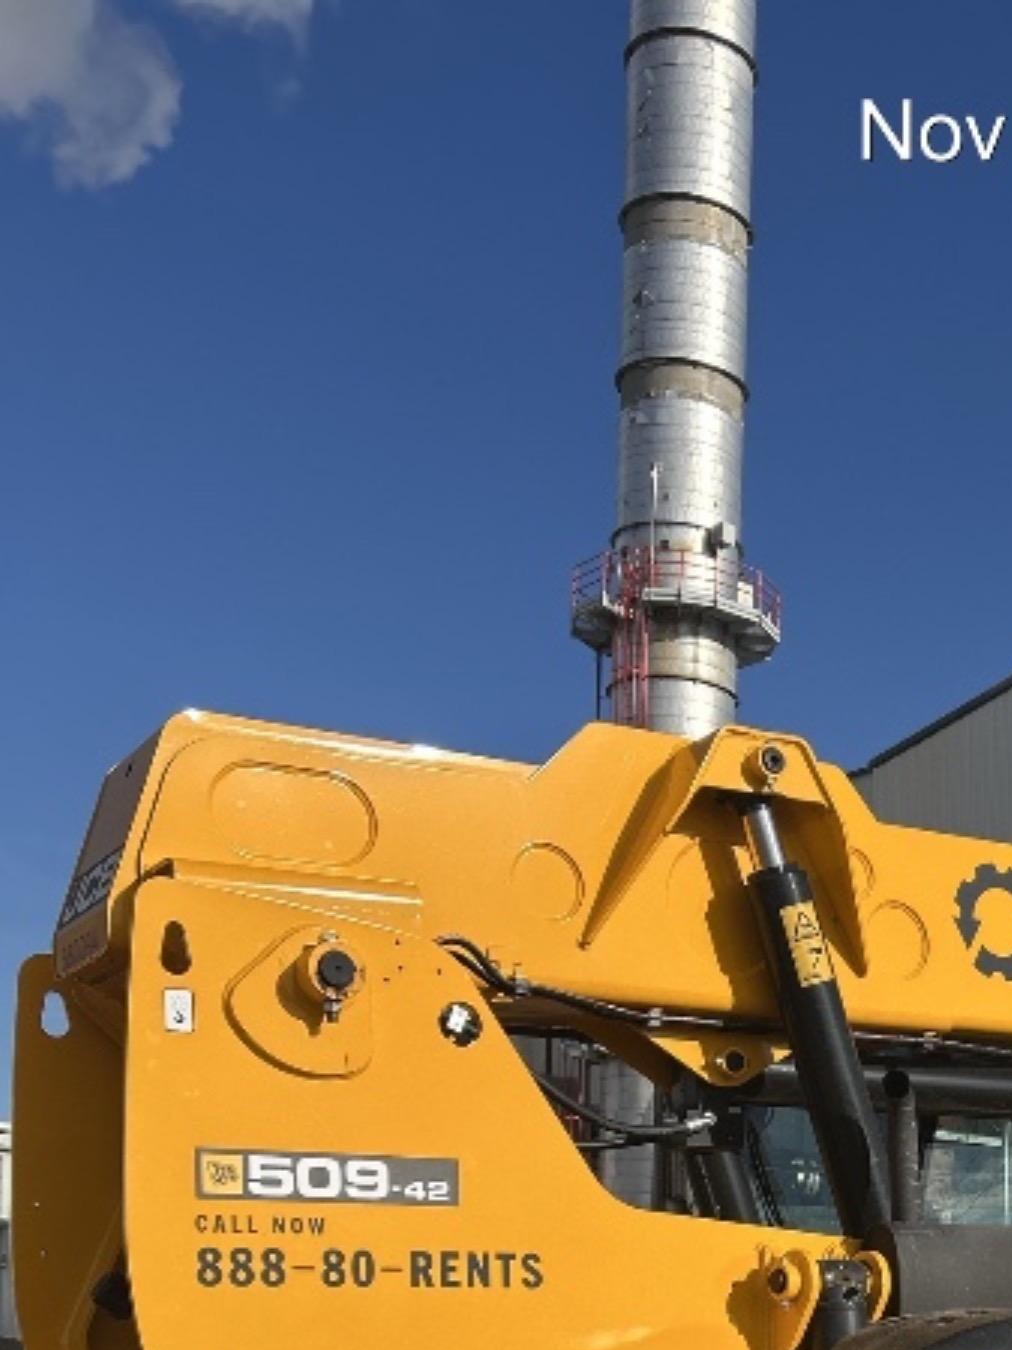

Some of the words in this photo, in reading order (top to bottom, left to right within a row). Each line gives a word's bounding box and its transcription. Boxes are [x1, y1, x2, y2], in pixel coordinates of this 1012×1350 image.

[195, 1214, 258, 1234] CALL
[272, 1217, 325, 1235] NOW
[197, 1247, 544, 1289] 888-80-RENTS
